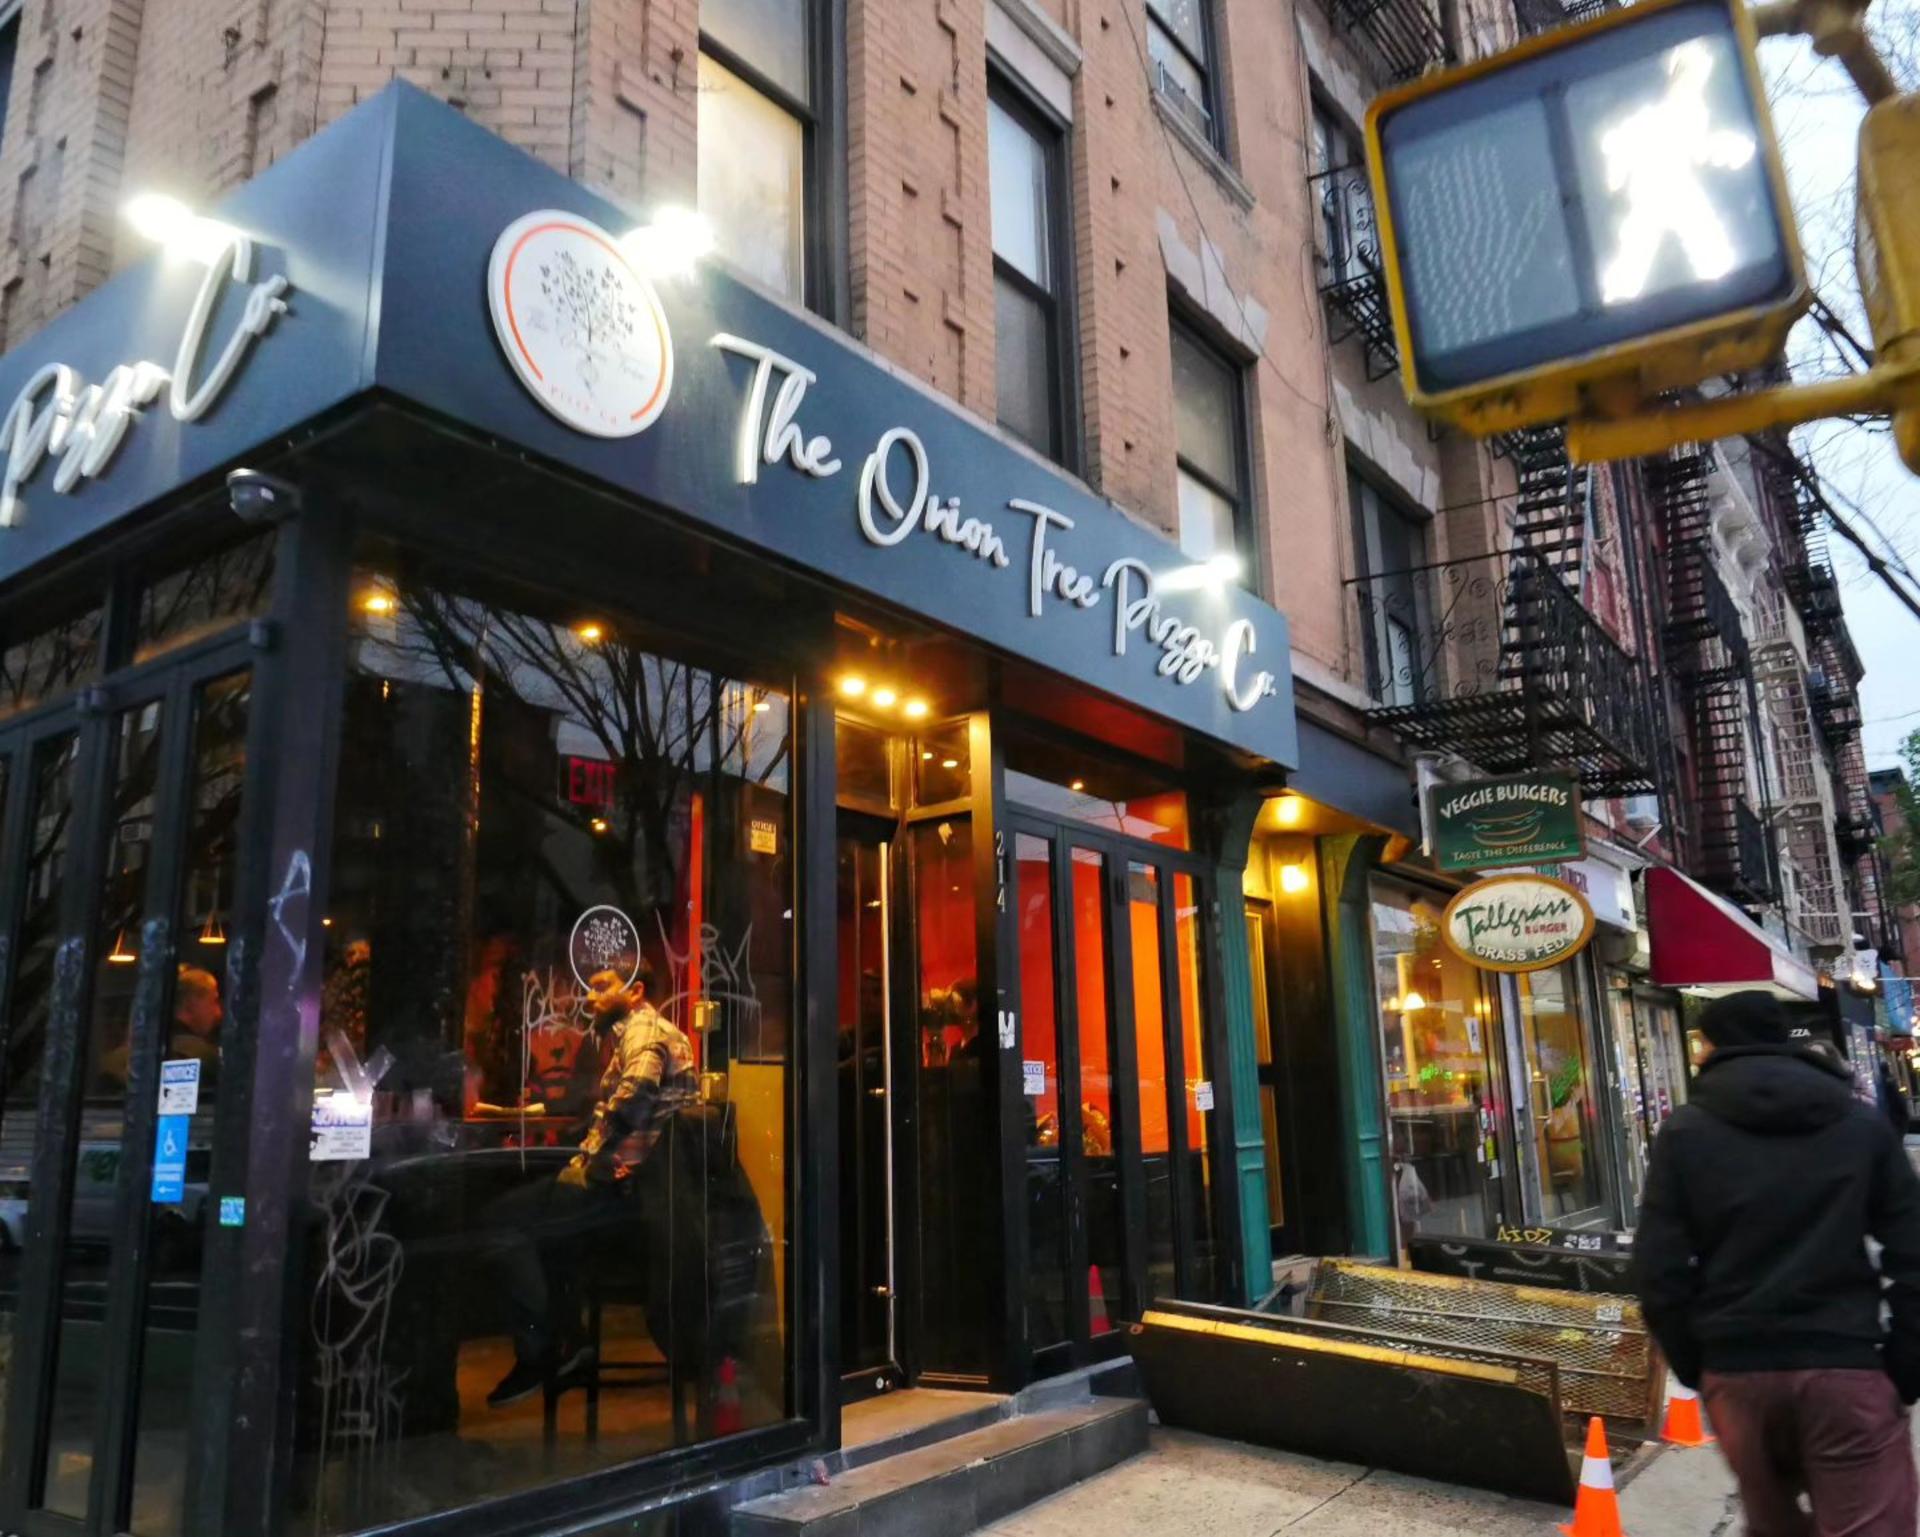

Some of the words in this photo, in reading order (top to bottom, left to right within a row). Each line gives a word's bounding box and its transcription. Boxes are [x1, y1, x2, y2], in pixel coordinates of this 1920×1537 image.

[711, 332, 842, 484] The
[858, 427, 1009, 567] Onion
[1010, 498, 1100, 617] Tree
[1103, 557, 1219, 685] Pizza
[1440, 786, 1494, 819] VEGGIE
[1496, 784, 1569, 807] BURGERS
[1453, 850, 1481, 862] TASTE
[1484, 848, 1505, 859] THE
[1507, 841, 1567, 856] DIFFERENCE
[996, 830, 1005, 913] 214
[1455, 898, 1572, 946] Tallgrass
[1525, 922, 1568, 935] BURGER
[1475, 943, 1528, 961] GRASS
[1535, 938, 1566, 958] FED
[1789, 1028, 1811, 1037] ZZA
